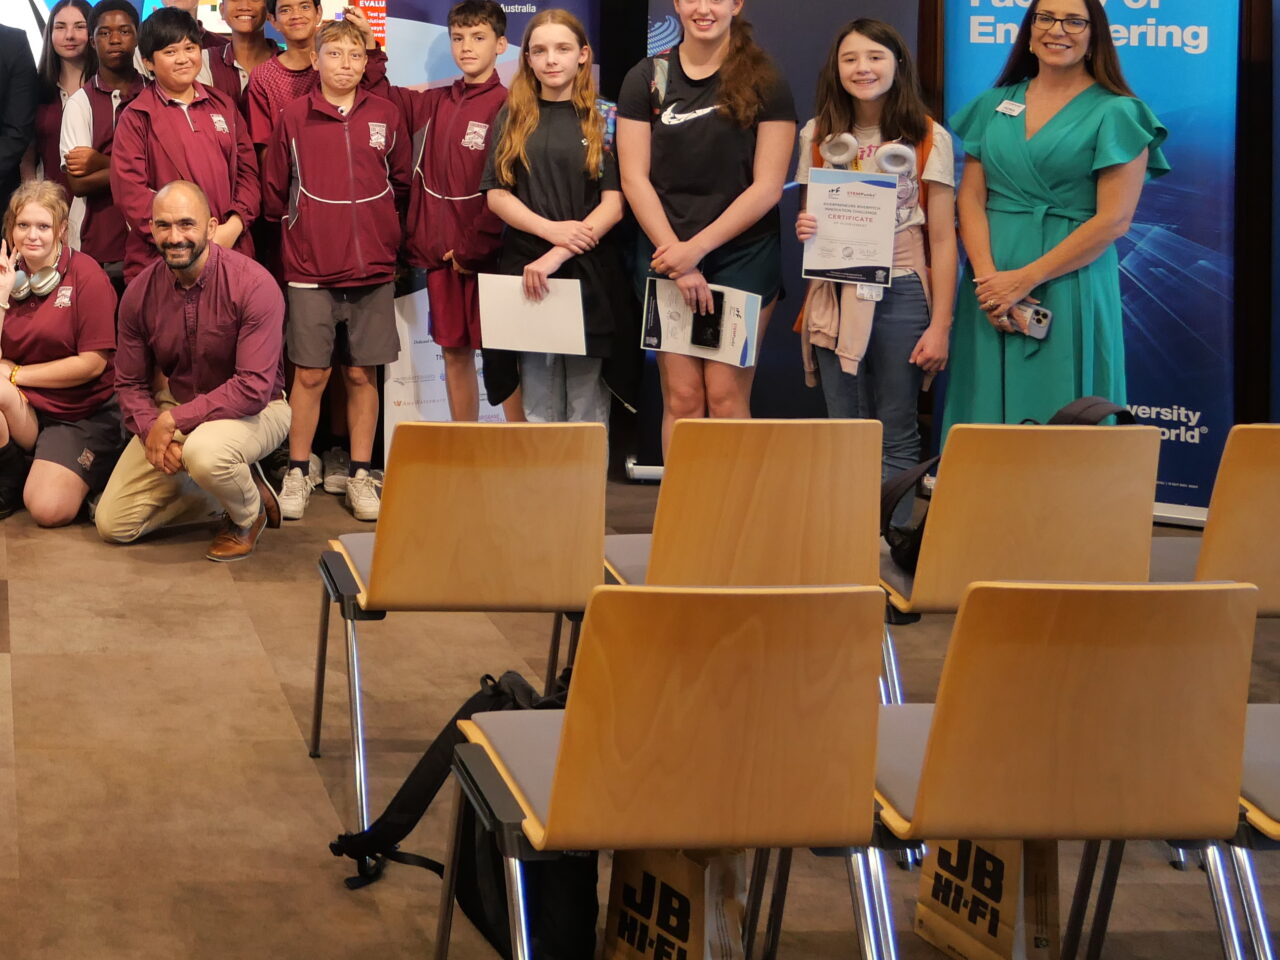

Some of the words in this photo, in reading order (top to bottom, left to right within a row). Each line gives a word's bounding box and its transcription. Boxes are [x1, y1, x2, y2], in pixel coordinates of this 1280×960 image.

[500, 4, 536, 13] Australia
[970, 16, 1208, 55] Enering
[827, 213, 874, 223] CERTIFICATE
[1126, 404, 1201, 426] versity
[938, 840, 1005, 904] JB
[622, 871, 691, 943] JB
